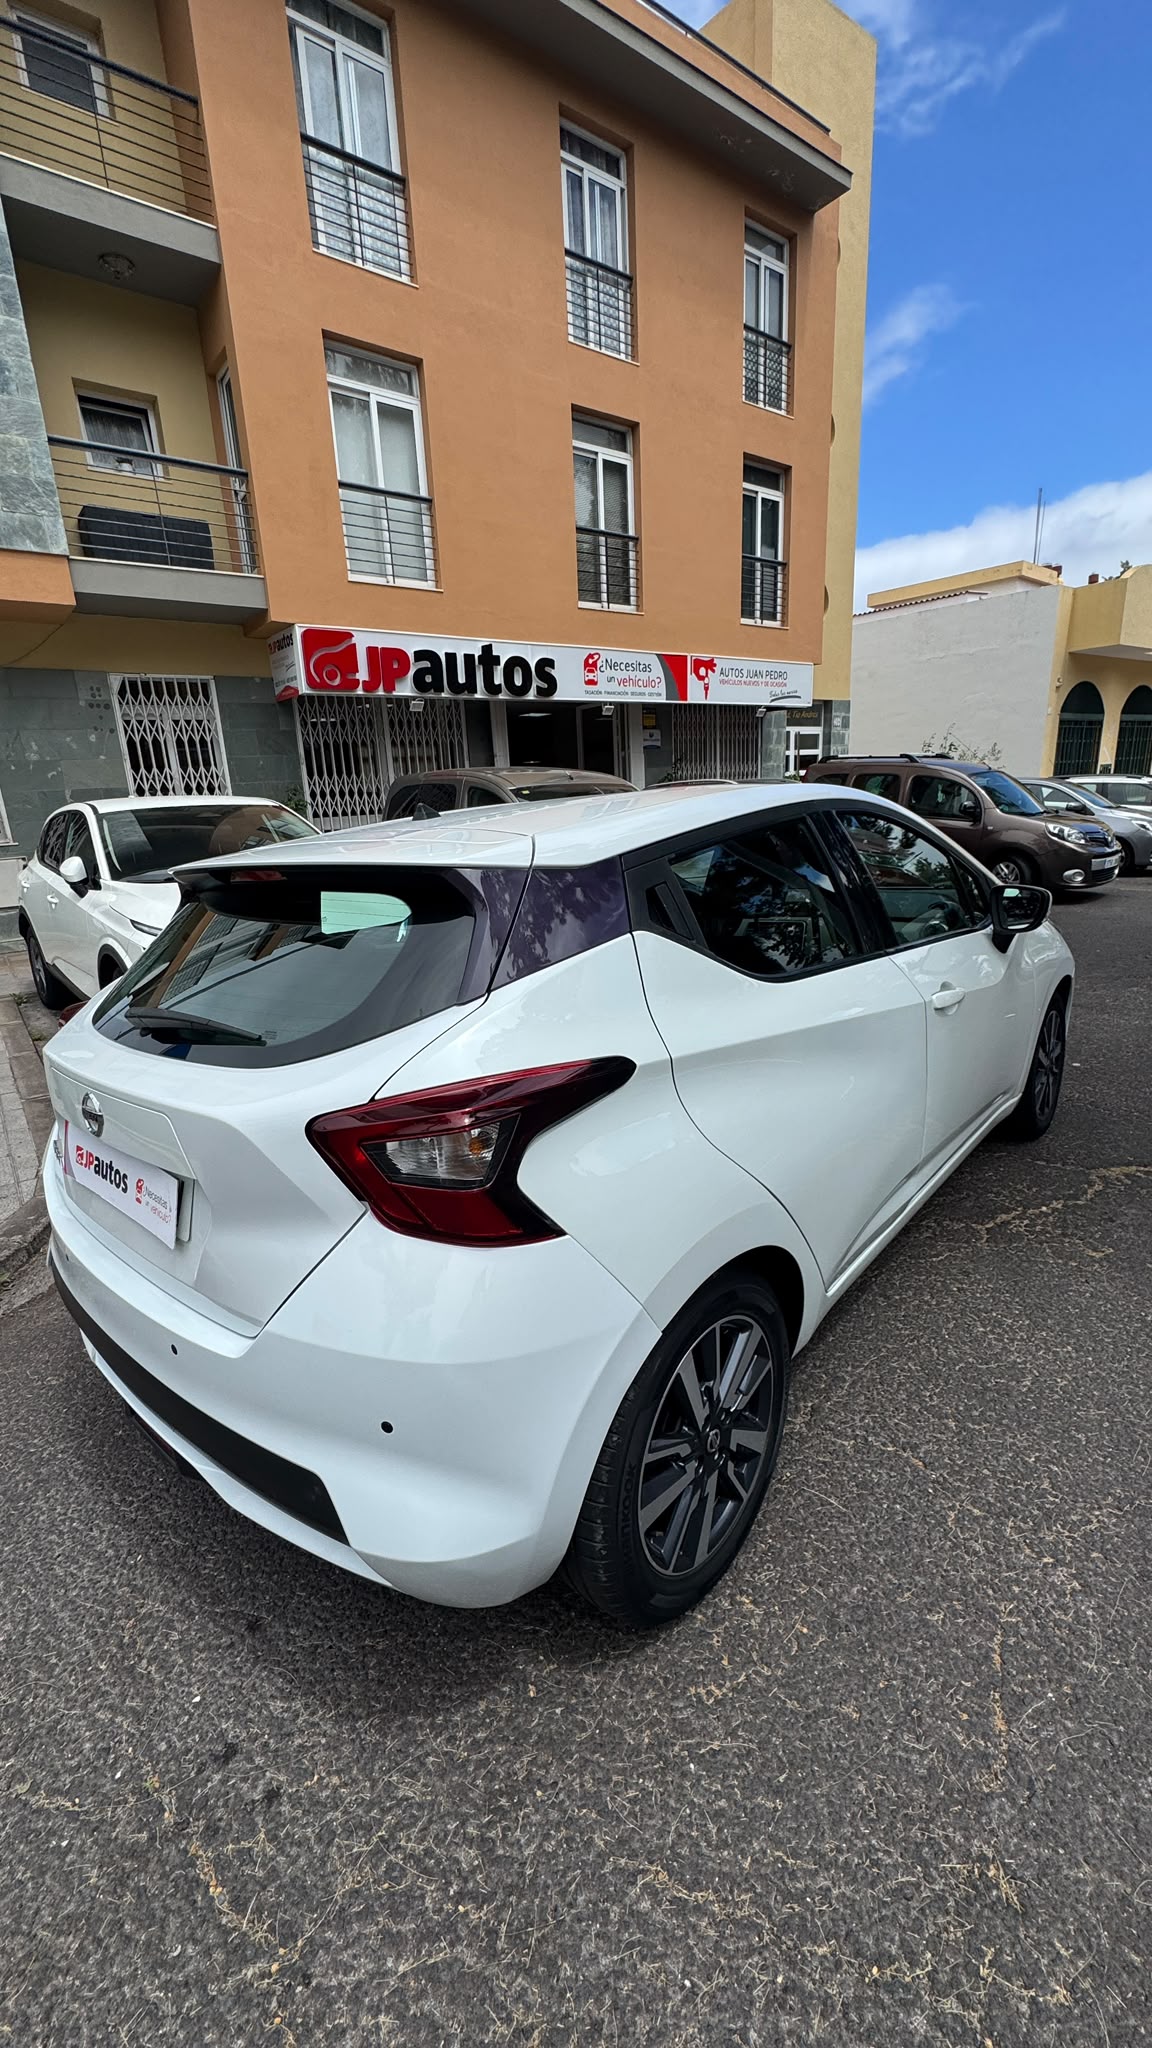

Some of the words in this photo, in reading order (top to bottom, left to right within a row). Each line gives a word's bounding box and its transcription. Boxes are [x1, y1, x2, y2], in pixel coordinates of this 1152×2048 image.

[362, 643, 558, 698] JPautos
[599, 658, 652, 673] ¿Necesitas
[616, 675, 662, 688] vehículo?
[719, 667, 744, 679] AUTOS
[745, 669, 763, 680] JUAN
[765, 670, 788, 681] PEDRO
[84, 1150, 128, 1194] JPautos
